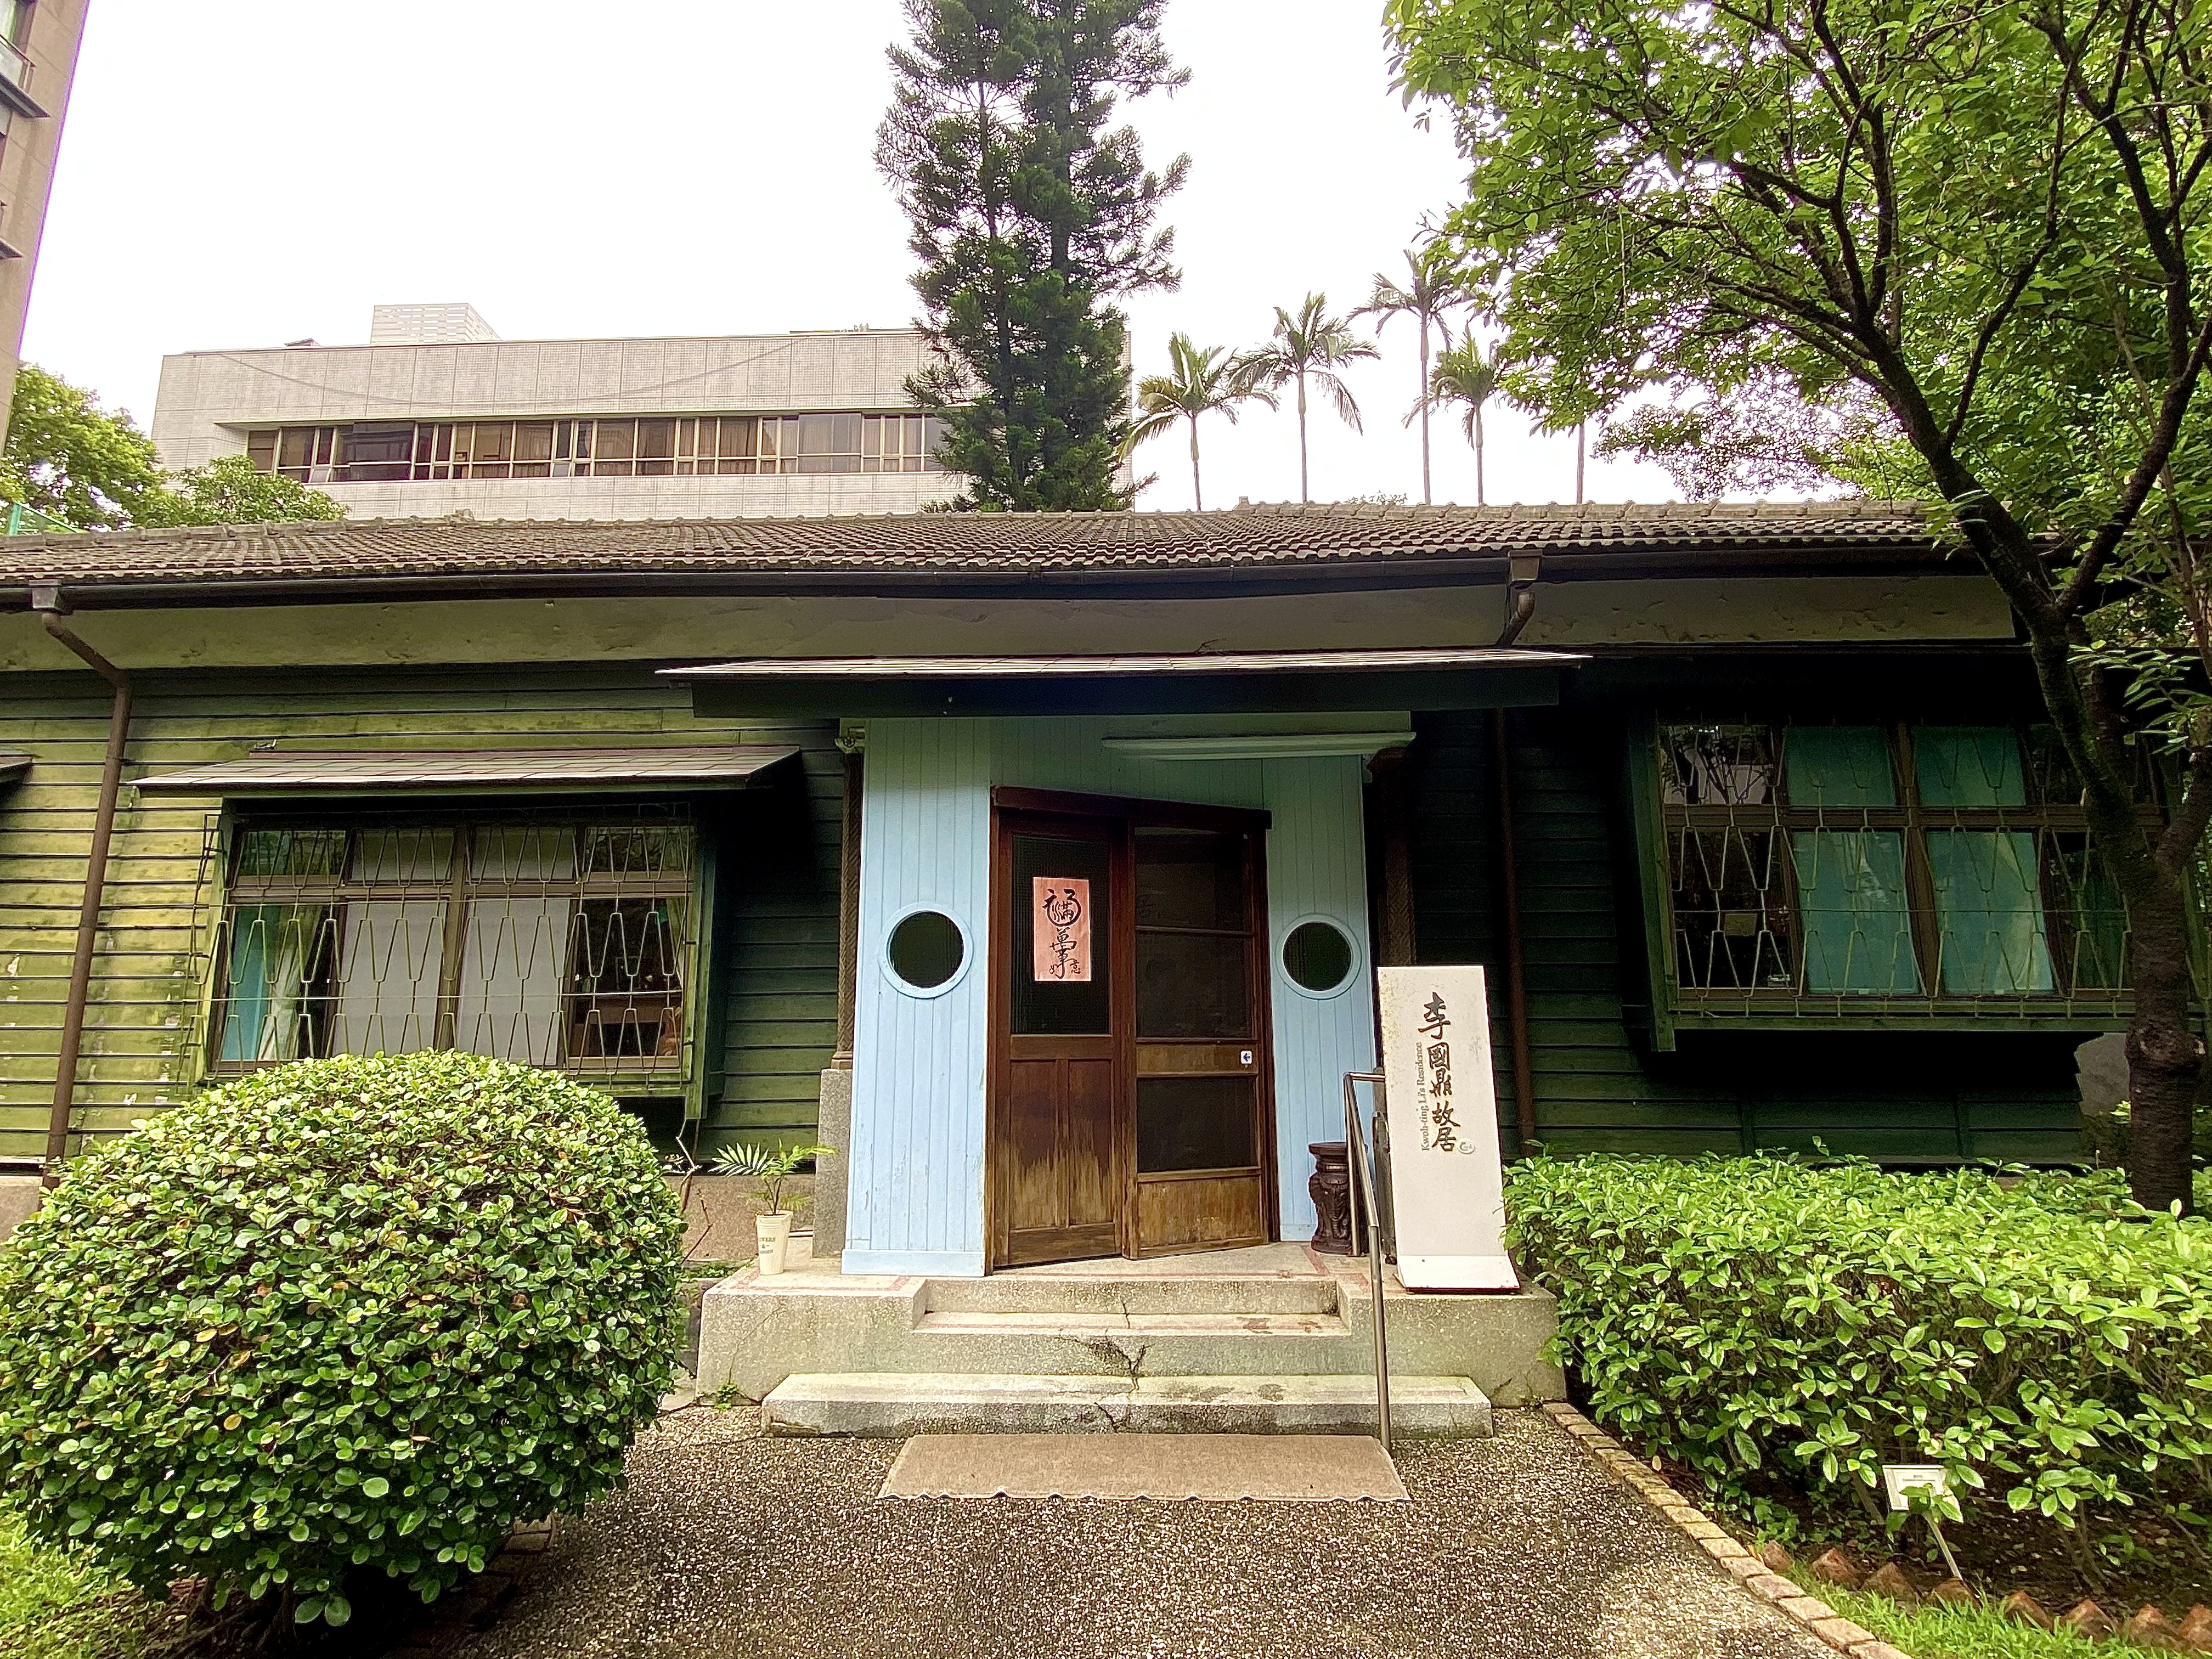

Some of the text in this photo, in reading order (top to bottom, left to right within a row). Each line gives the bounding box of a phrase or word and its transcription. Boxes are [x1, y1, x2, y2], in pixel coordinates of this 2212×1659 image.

[1415, 1042, 1425, 1085] Residence
[1418, 991, 1460, 1152] 李國鼎故居
[1416, 1105, 1430, 1151] Kwoh-ting
